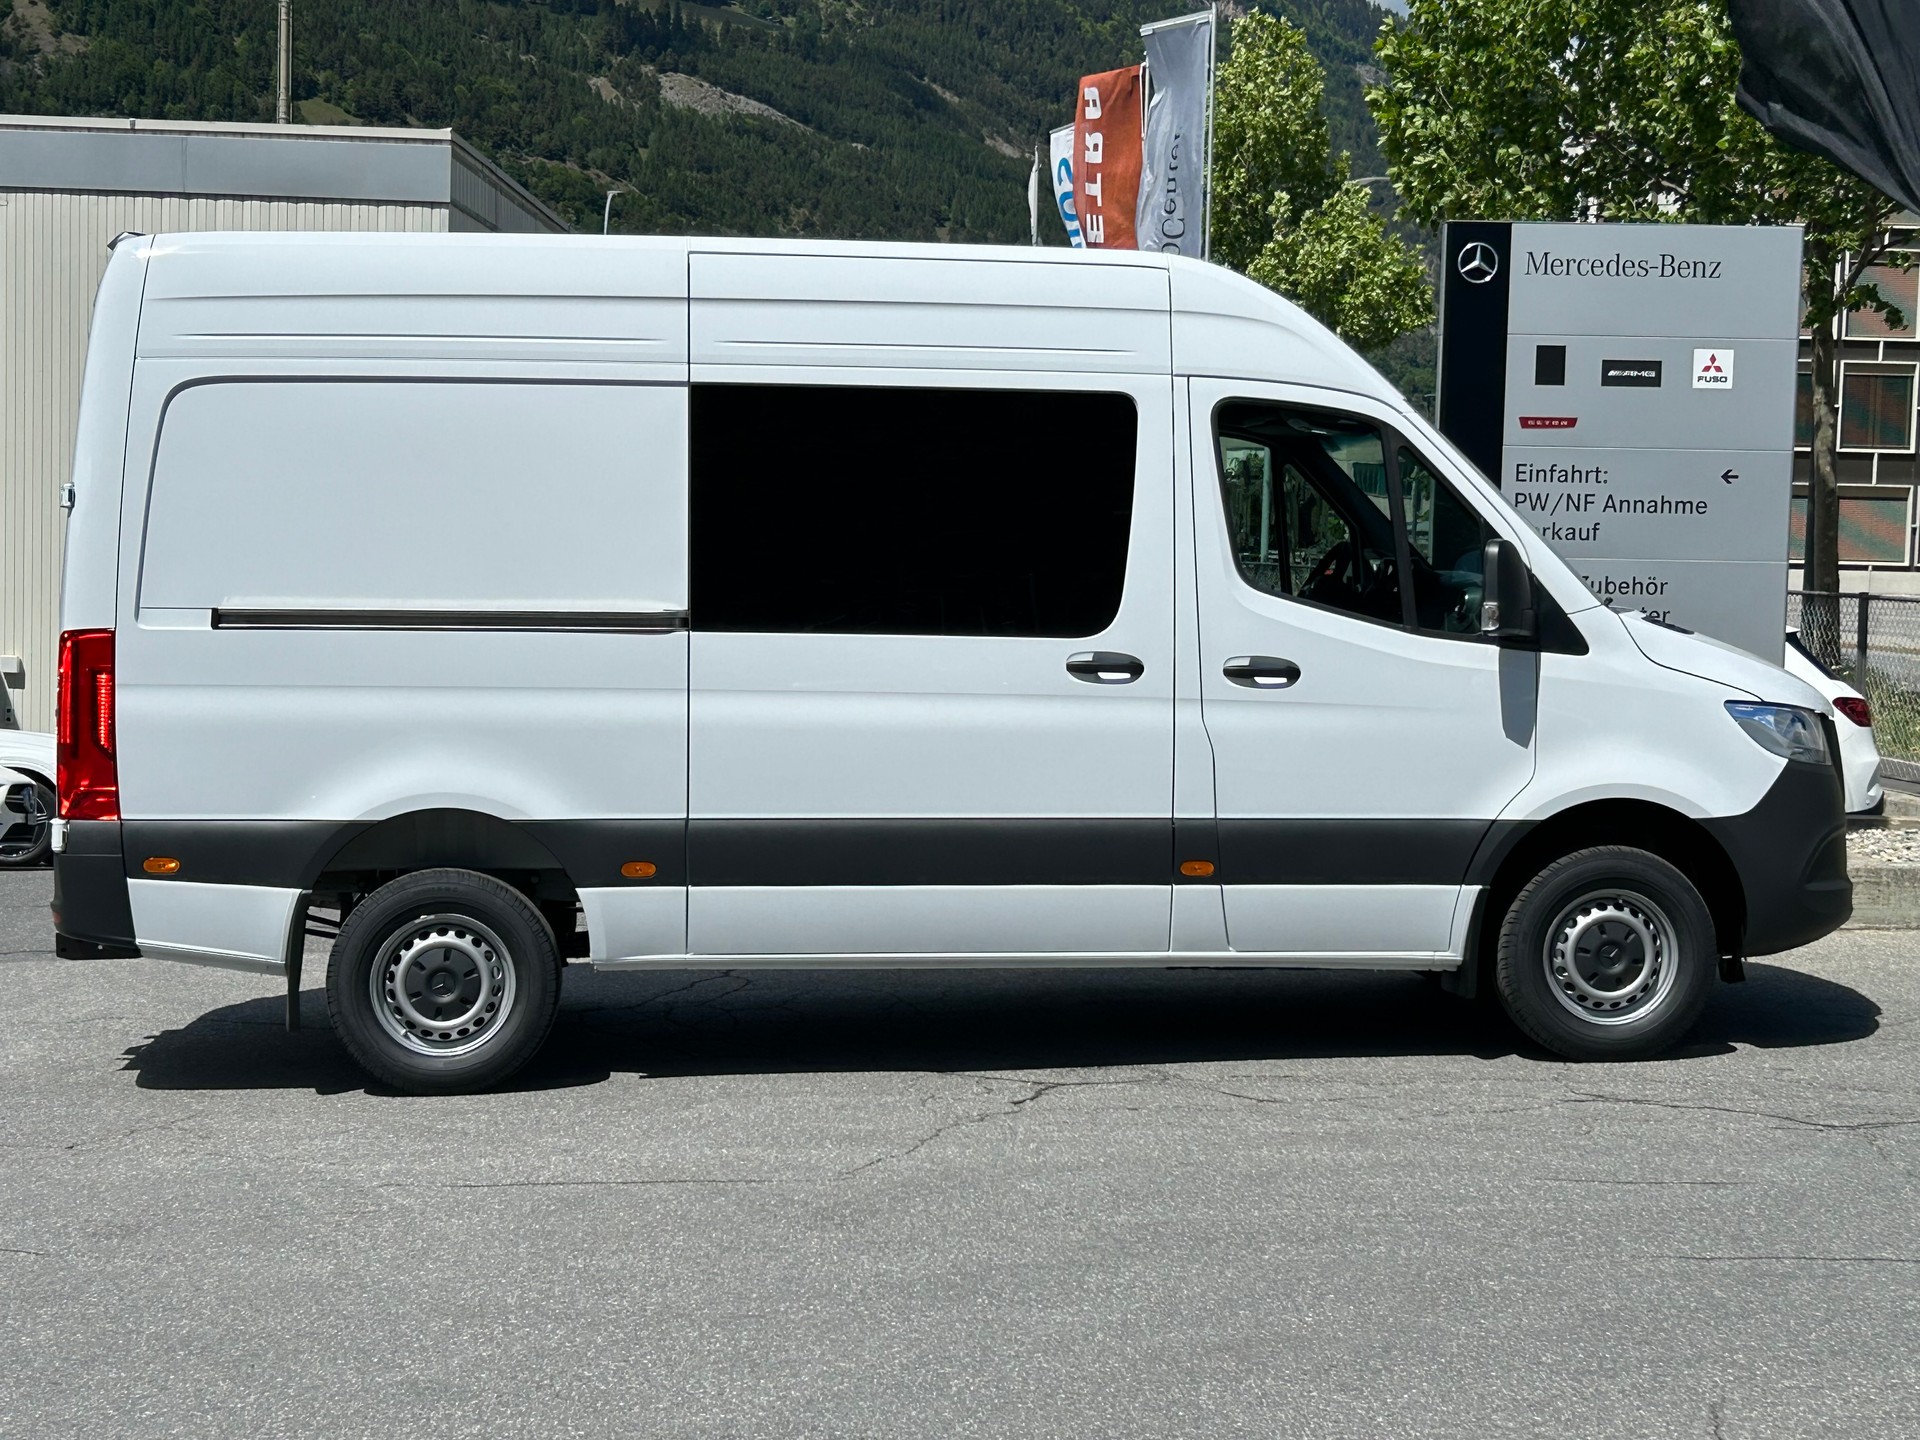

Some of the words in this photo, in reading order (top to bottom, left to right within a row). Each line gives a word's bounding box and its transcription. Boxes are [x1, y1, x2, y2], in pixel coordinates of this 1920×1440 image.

[1524, 251, 1722, 279] Mercedes-Benz
[1697, 375, 1728, 383] FUSO
[1515, 463, 1609, 485] Einfahrt:
[1514, 492, 1596, 517] PW/NF
[1602, 494, 1708, 515] Annahme
[1541, 521, 1601, 542] rkauf
